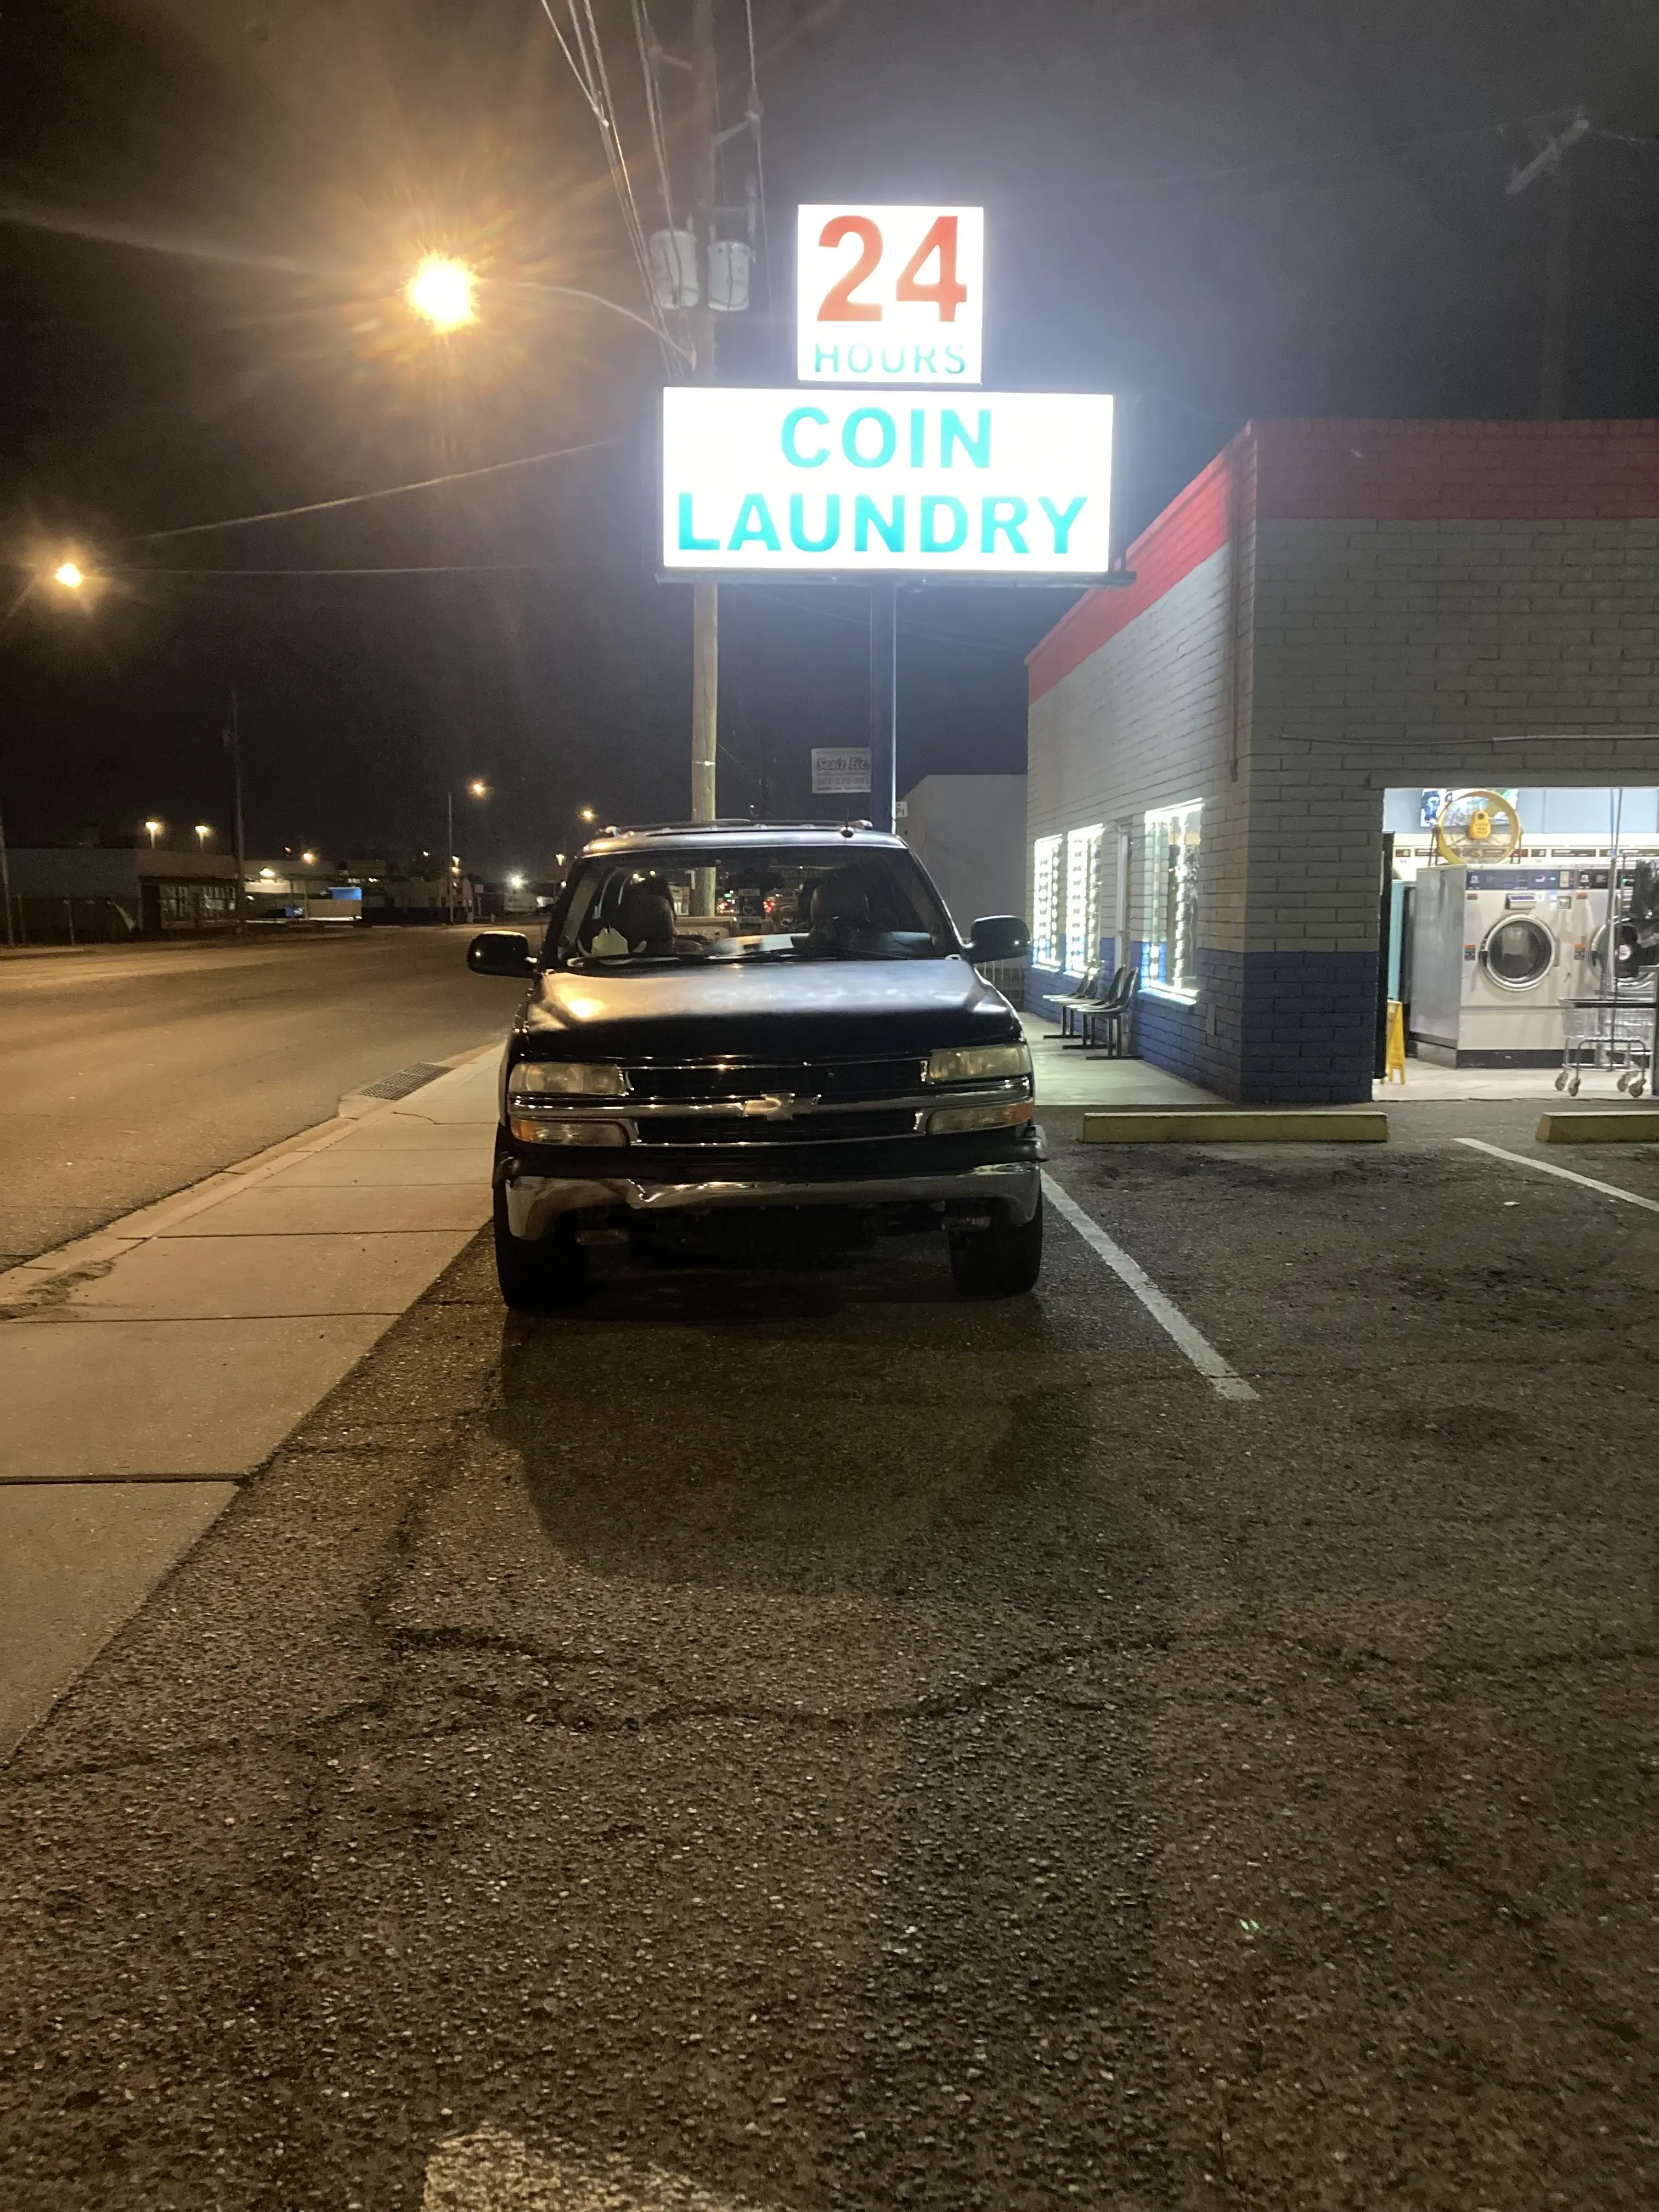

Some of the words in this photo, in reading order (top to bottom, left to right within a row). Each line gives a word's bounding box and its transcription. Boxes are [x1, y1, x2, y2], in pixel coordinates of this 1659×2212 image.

[817, 216, 968, 323] 24
[814, 343, 966, 375] HOURS
[781, 407, 992, 469] COIN
[678, 492, 1088, 554] LAUNDRY
